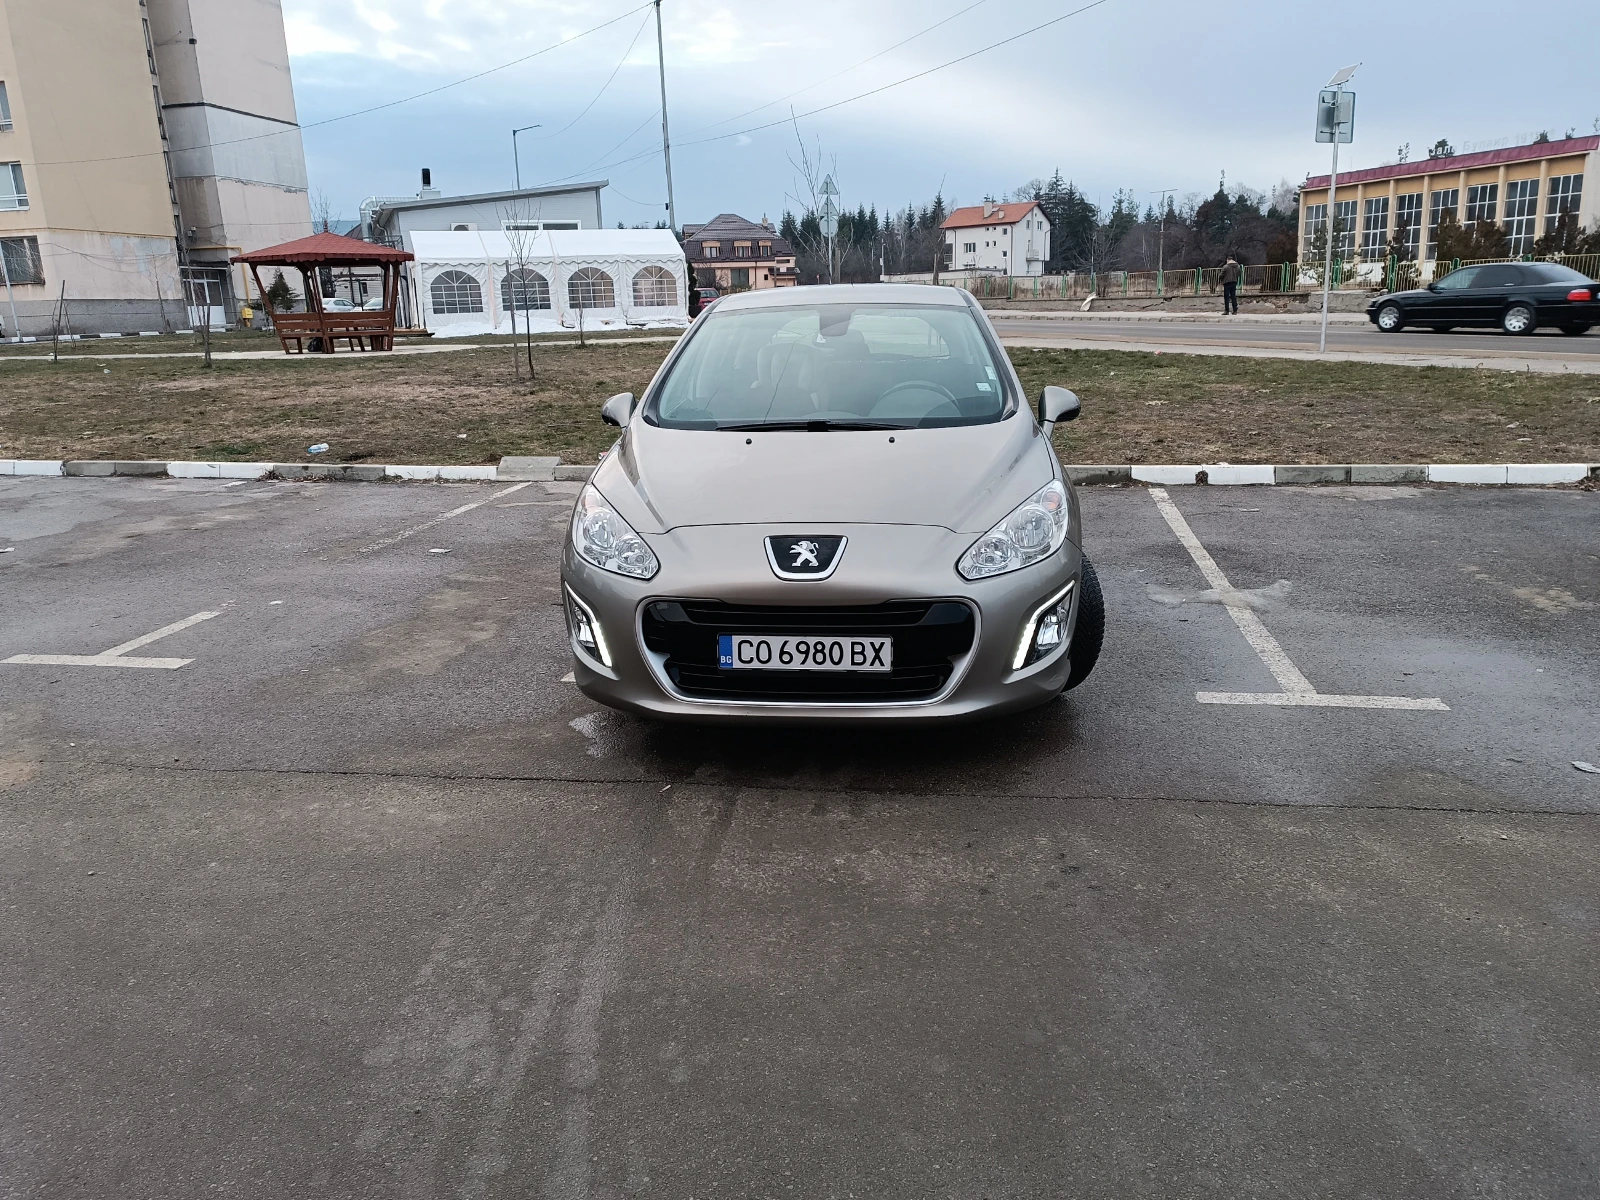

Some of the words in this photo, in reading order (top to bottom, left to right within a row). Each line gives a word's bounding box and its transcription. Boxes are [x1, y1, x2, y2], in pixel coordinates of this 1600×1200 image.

[720, 655, 732, 664] BG
[737, 639, 772, 665] CO
[778, 640, 844, 666] 6980
[850, 641, 886, 667] BX
